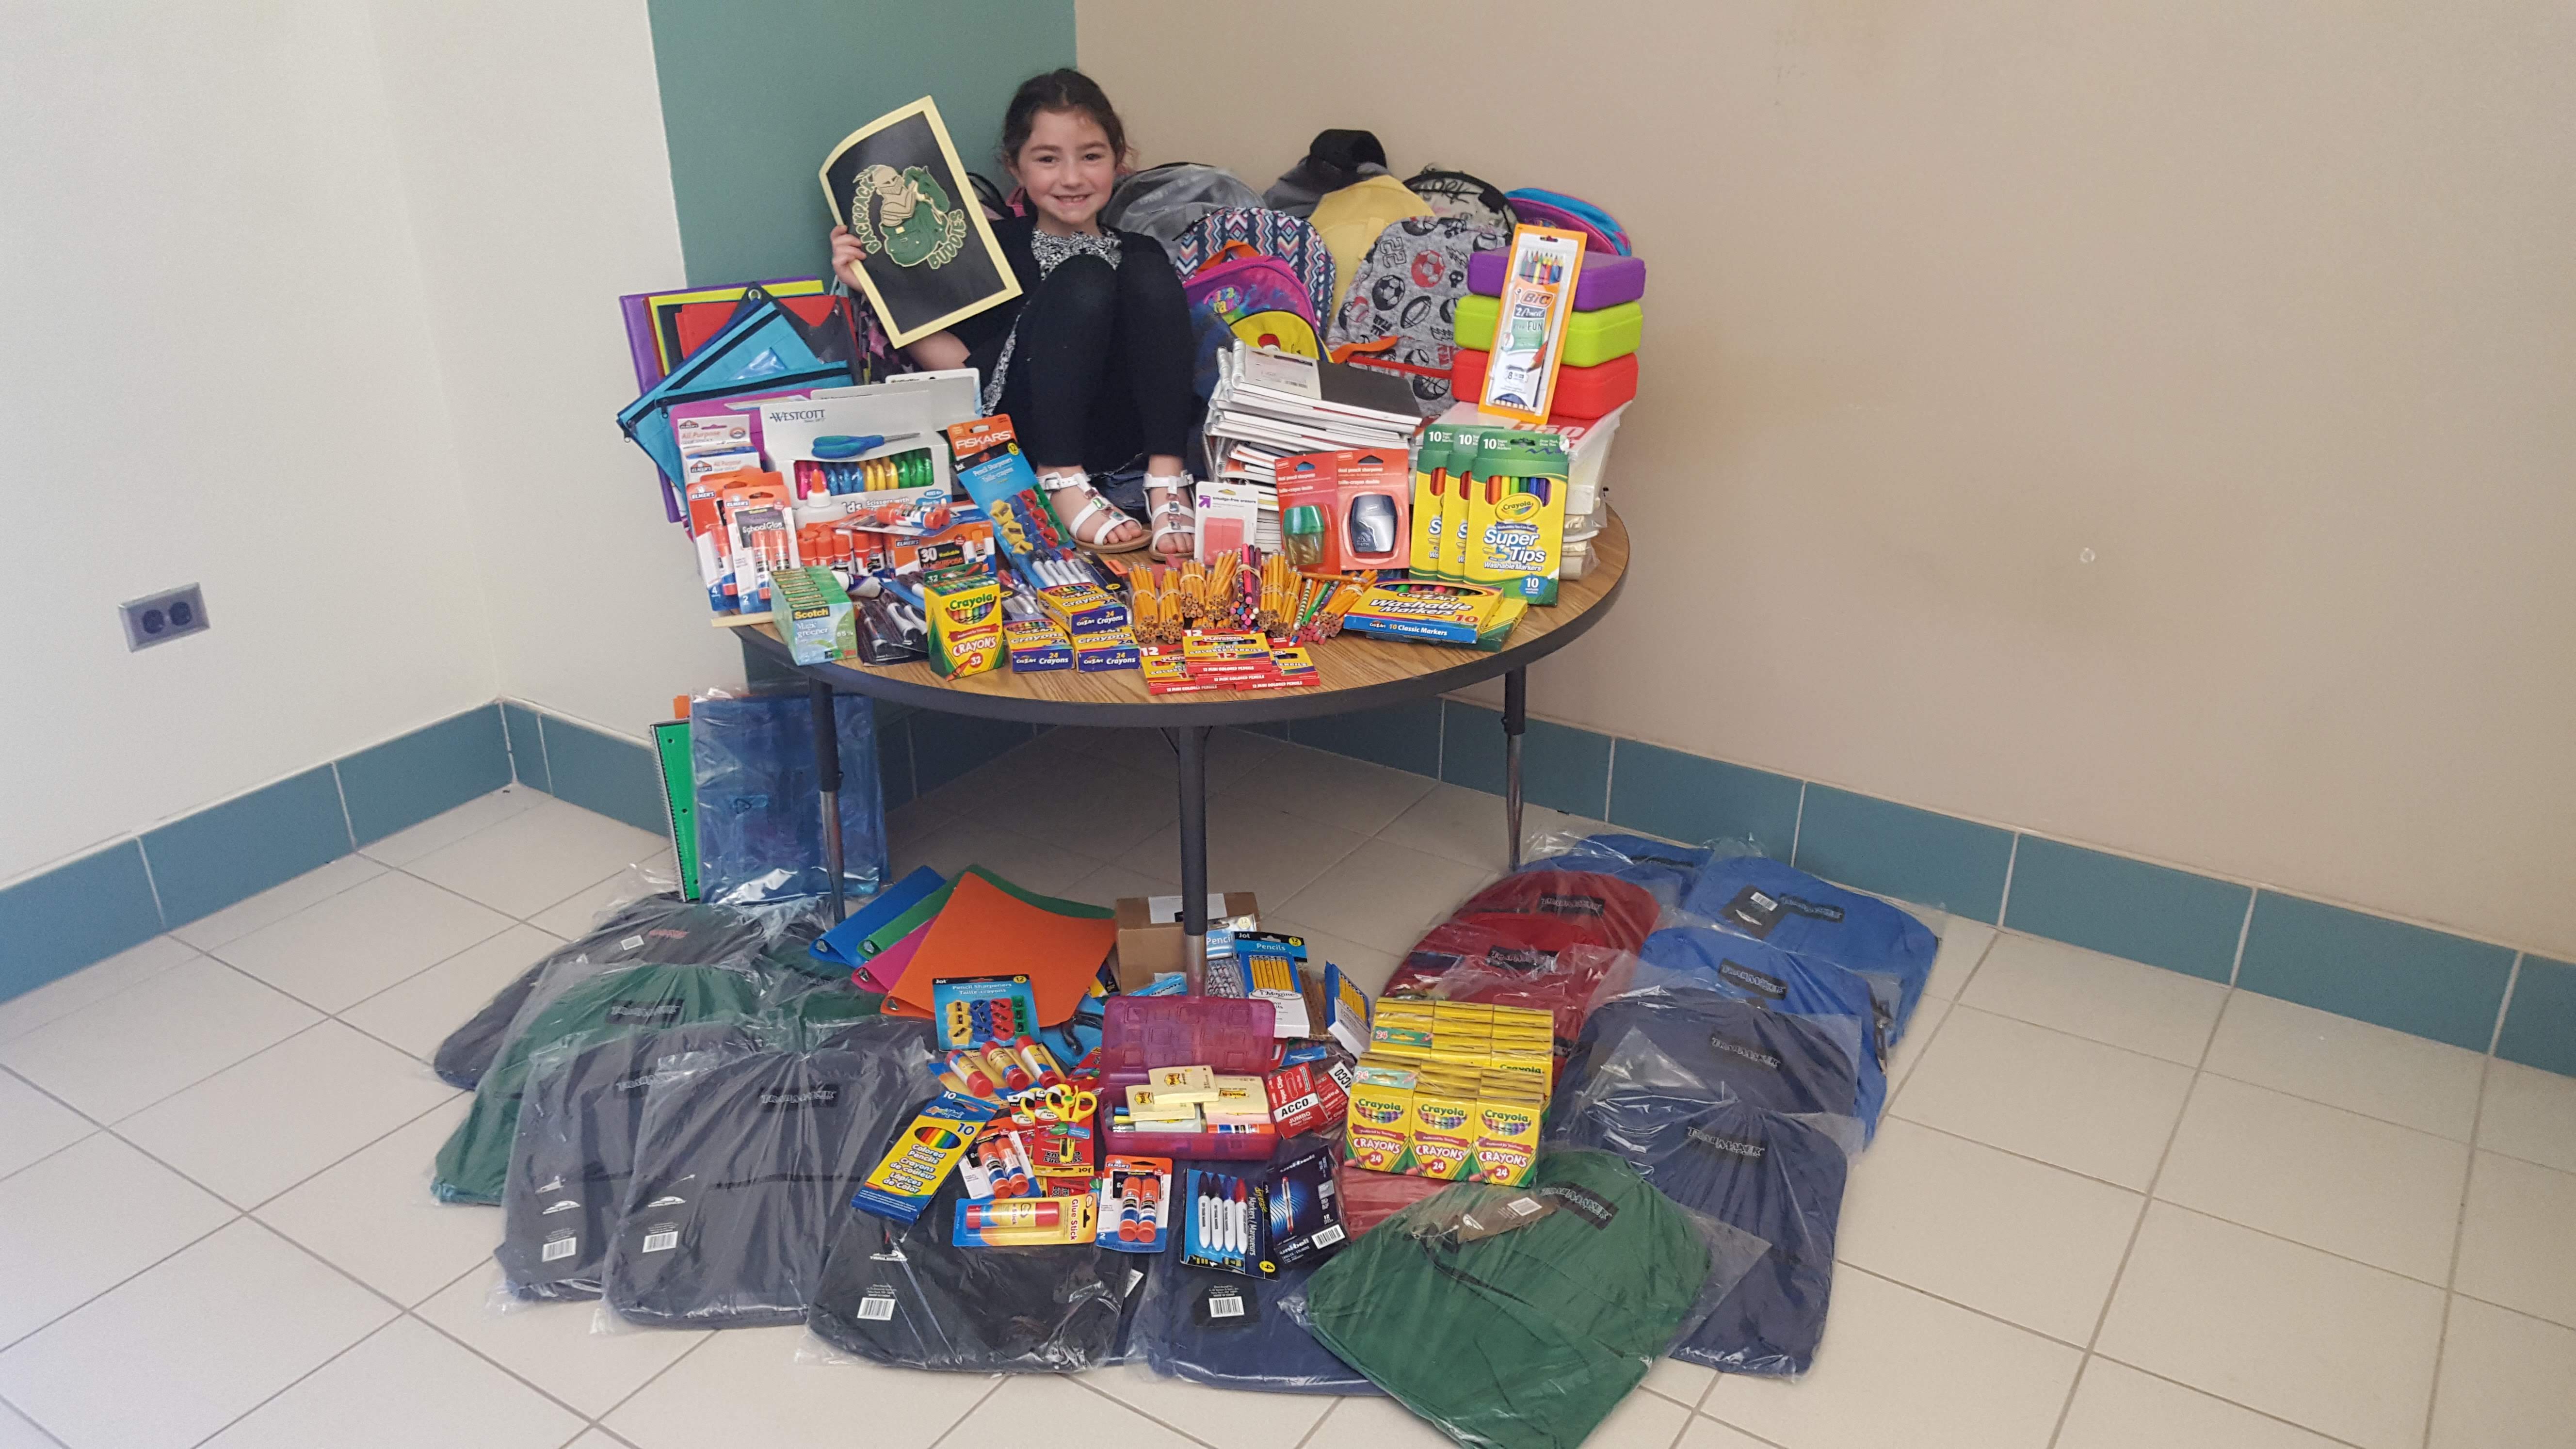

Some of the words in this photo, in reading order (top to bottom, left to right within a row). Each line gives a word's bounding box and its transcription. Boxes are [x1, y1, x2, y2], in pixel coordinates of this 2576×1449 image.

[852, 177, 883, 254] BACKPACK
[927, 209, 966, 269] BUDDIES
[770, 409, 825, 422] WESTCOTT
[955, 431, 1012, 450] FISKARS
[1429, 431, 1442, 442] 10
[1459, 434, 1472, 445] 10
[1009, 444, 1017, 452] 12
[1483, 438, 1497, 450] 10
[1503, 500, 1531, 511] Crayola
[742, 523, 767, 533] School
[1483, 528, 1540, 547] Super
[921, 547, 938, 563] 30
[1510, 546, 1546, 564] Tips
[1484, 562, 1515, 570] Washable
[1515, 563, 1543, 572] Markers
[1526, 578, 1539, 588] 10
[949, 593, 993, 610] Crayola
[1063, 593, 1110, 607] Crayons
[1369, 599, 1474, 611] Washable
[794, 608, 828, 620] Scotch
[1379, 607, 1455, 616] Markers
[1096, 615, 1124, 624] Crayons
[1455, 614, 1480, 624] 10
[797, 628, 829, 638] greener
[1398, 625, 1420, 633] Classic
[1420, 627, 1448, 636] Markers
[1011, 633, 1064, 644] Crayons
[1078, 633, 1131, 644] Crayons
[952, 636, 997, 657] CRAYONS
[1141, 646, 1159, 656] 12
[970, 656, 982, 665] 32
[1256, 943, 1286, 951] Pencils
[1376, 1030, 1388, 1040] 24
[1357, 1071, 1369, 1080] 24
[943, 1091, 957, 1100] 10
[1281, 1098, 1309, 1117] ACCO
[1358, 1098, 1401, 1111] Crayola
[1421, 1103, 1465, 1117] Crayola
[1288, 1111, 1311, 1124] JUMBO
[1484, 1109, 1529, 1123] Crayola
[957, 1123, 976, 1136] 10
[912, 1143, 946, 1159] Colored
[1353, 1138, 1401, 1154] CRAYONS
[908, 1150, 940, 1164] Pencils
[1370, 1154, 1382, 1162] 24
[1415, 1145, 1464, 1161] CRAYONS
[1479, 1151, 1528, 1168] CRAYONS
[889, 1162, 901, 1171] de
[902, 1166, 936, 1181] couleur
[900, 1157, 935, 1173] Crayons
[1432, 1161, 1445, 1170] 24
[1495, 1168, 1508, 1176] 24
[883, 1177, 894, 1186] de
[896, 1181, 920, 1194] Color
[890, 1172, 923, 1187] Lápices
[1248, 1196, 1256, 1221] Markers
[1070, 1220, 1078, 1240] Stick
[1249, 1224, 1257, 1256] Marqueurs
